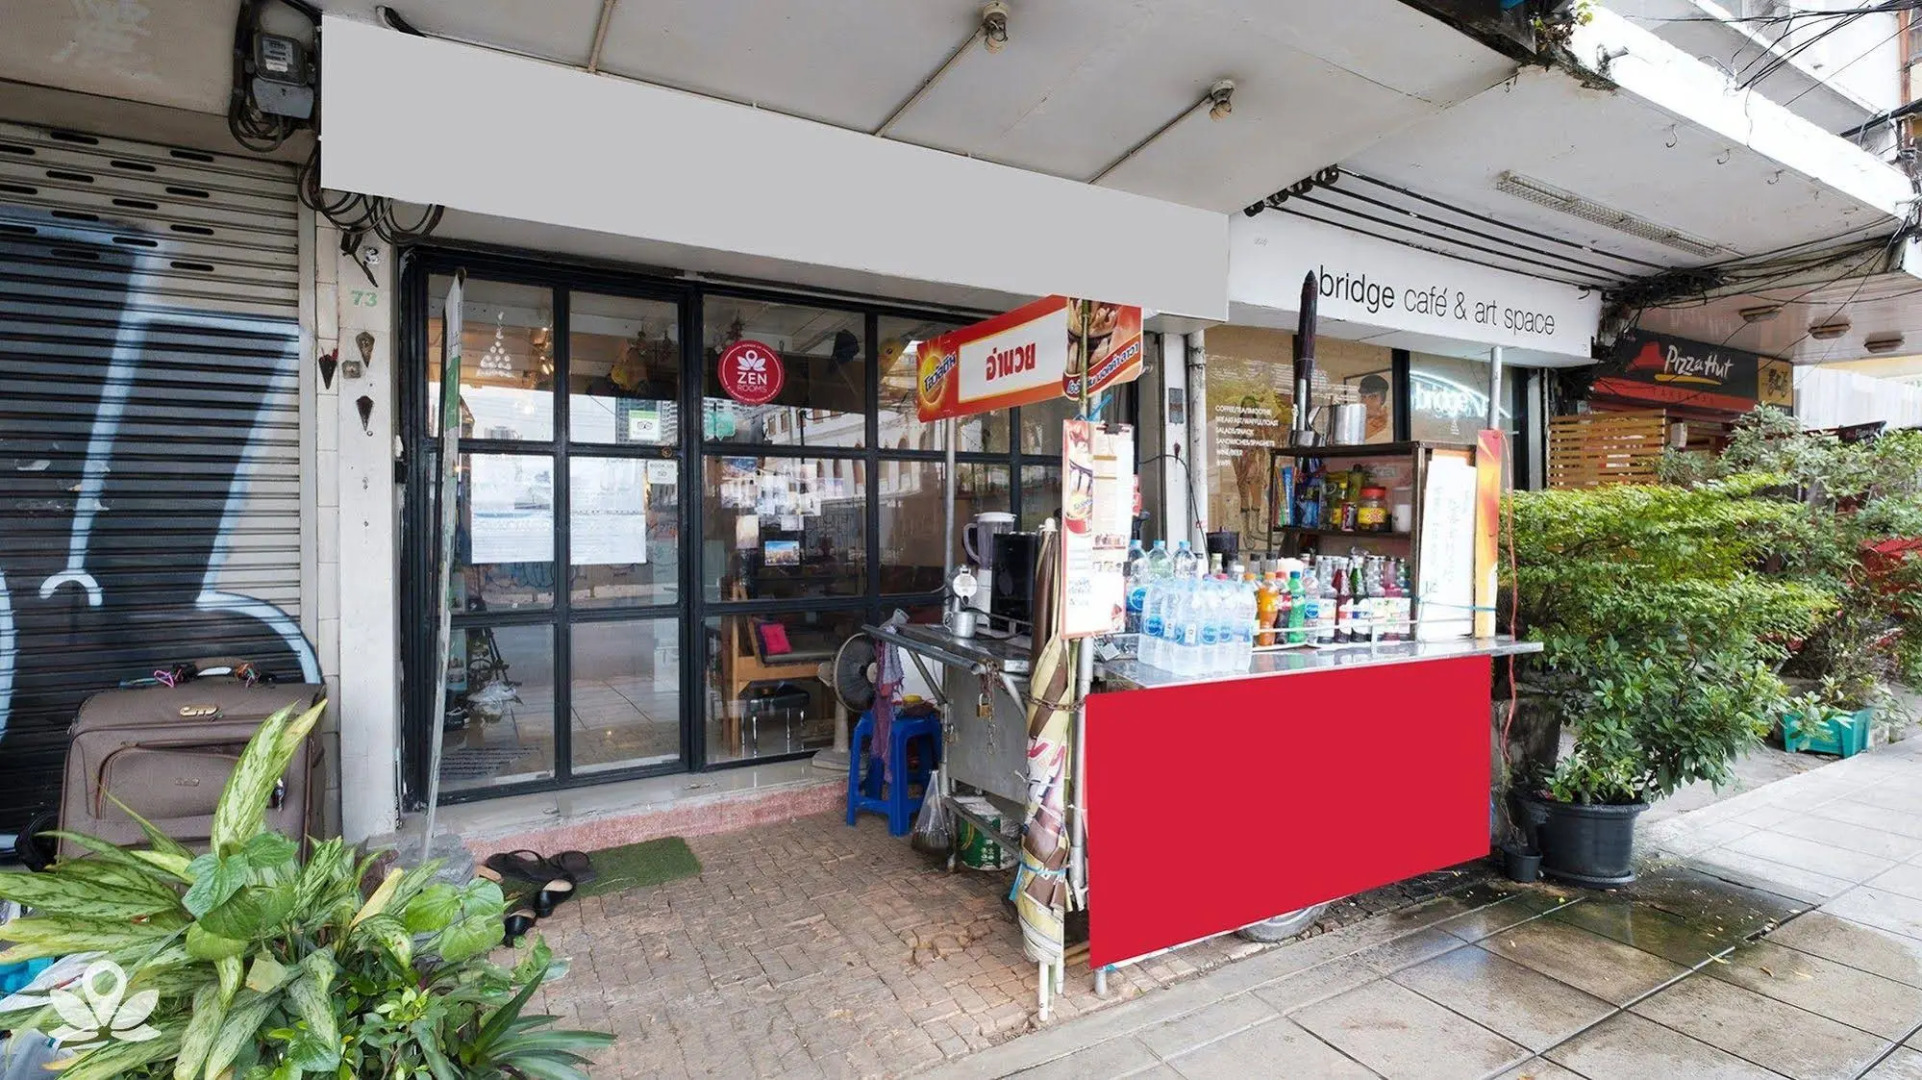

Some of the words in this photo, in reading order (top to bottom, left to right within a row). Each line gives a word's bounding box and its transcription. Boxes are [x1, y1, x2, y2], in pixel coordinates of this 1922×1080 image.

[351, 289, 378, 307] 73
[1319, 264, 1395, 314] bridge
[1403, 285, 1448, 318] café
[1453, 291, 1468, 321] &
[1474, 299, 1498, 327] art
[1503, 307, 1556, 336] space
[1663, 344, 1704, 376] Pizza
[1704, 353, 1735, 379] Hut
[736, 371, 768, 386] ZEN
